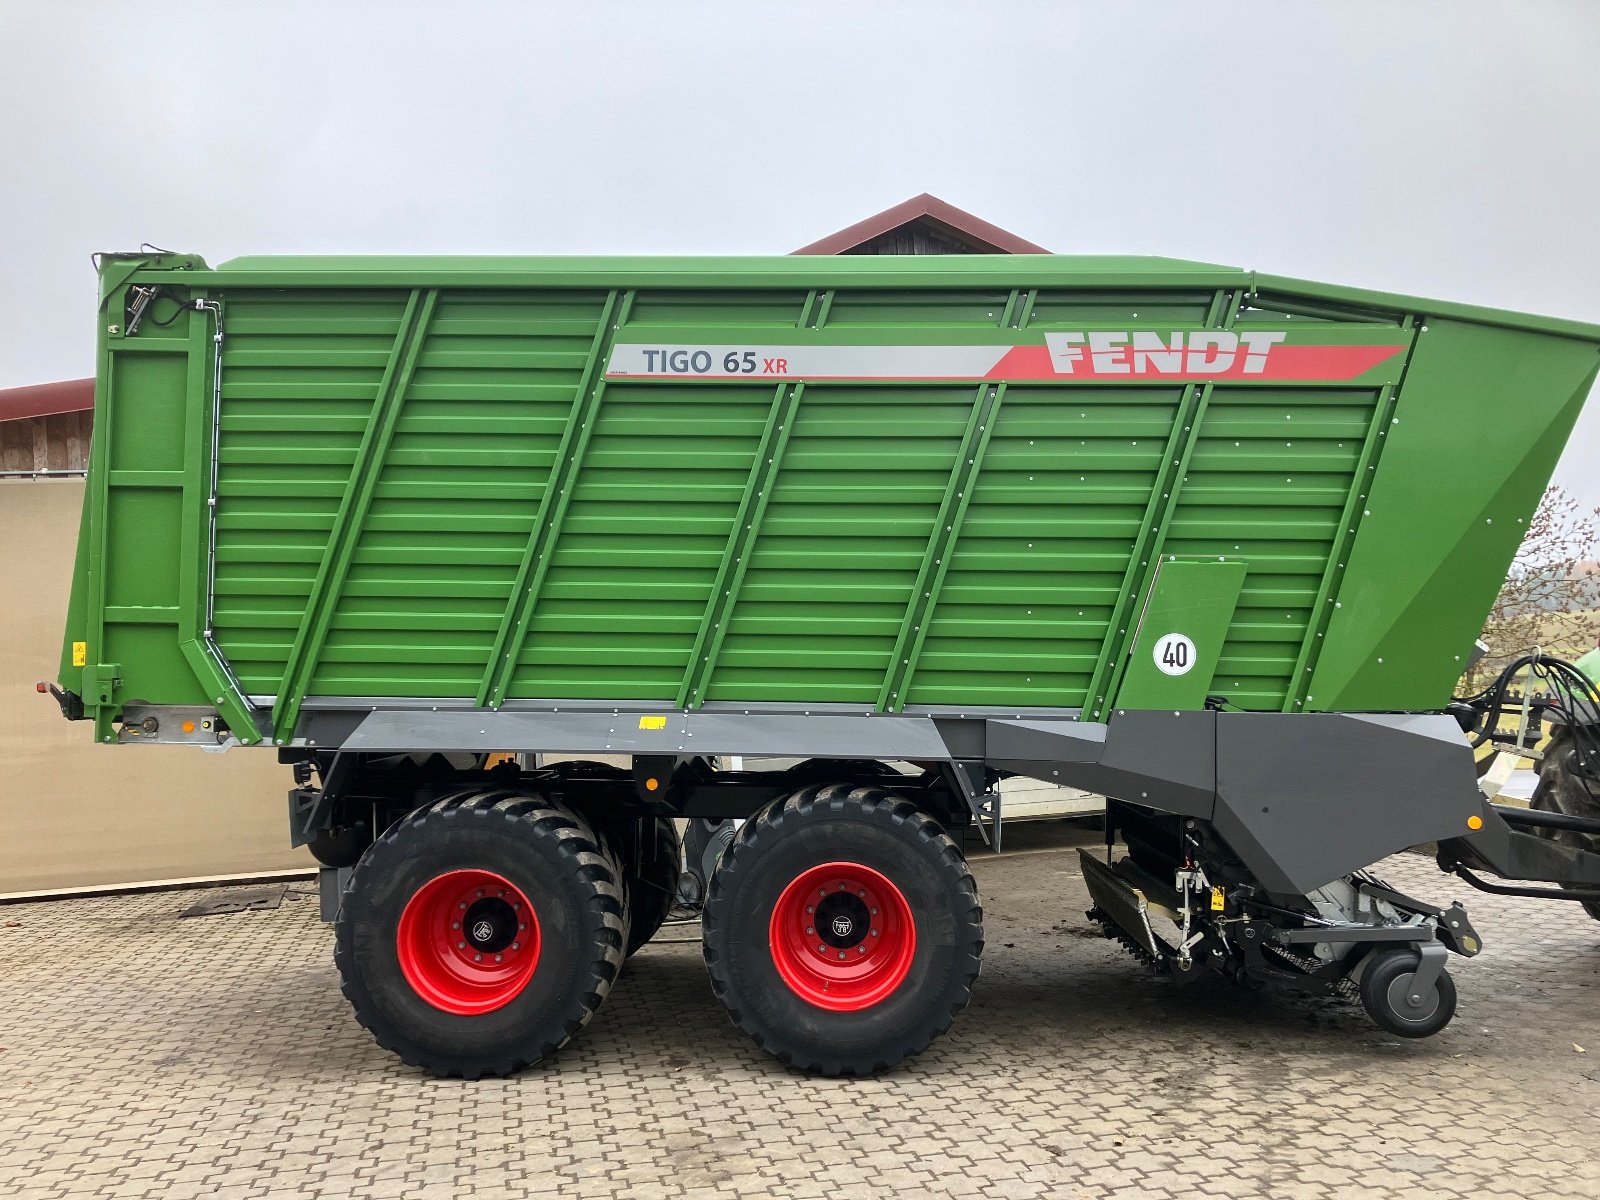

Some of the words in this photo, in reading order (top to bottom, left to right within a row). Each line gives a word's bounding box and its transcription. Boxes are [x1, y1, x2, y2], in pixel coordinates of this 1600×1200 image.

[642, 350, 712, 373] TIGO
[723, 351, 757, 373] 65
[762, 358, 788, 374] XR
[1043, 331, 1287, 374] FENDT
[1162, 641, 1188, 668] 40
